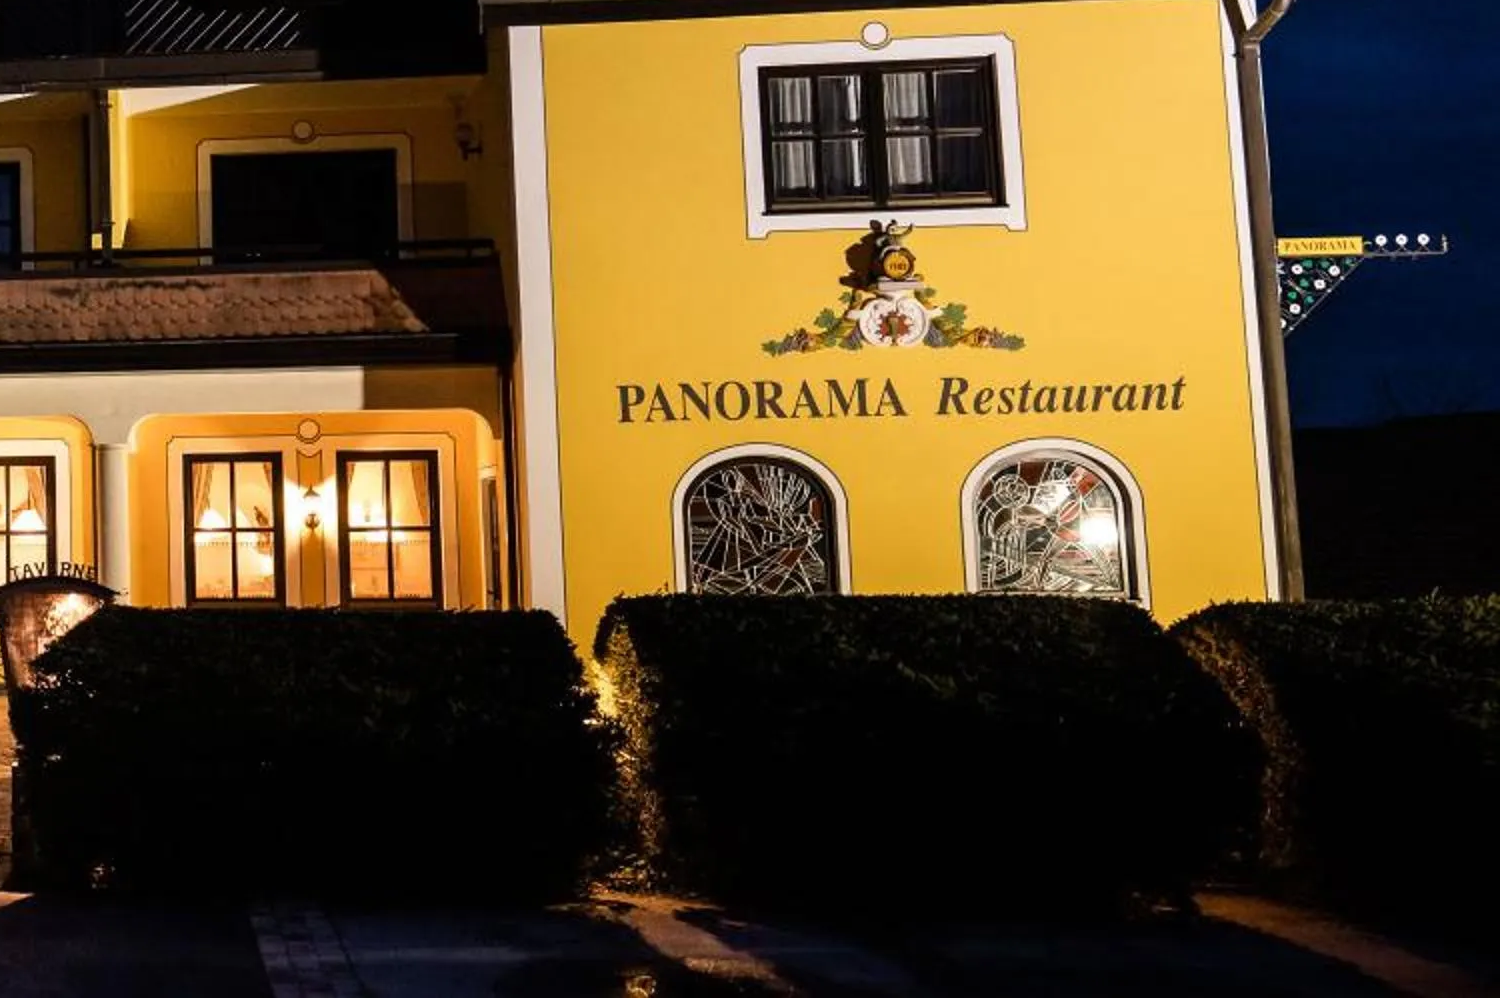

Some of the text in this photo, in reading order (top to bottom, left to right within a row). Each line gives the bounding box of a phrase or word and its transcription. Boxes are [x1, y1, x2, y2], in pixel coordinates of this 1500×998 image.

[1283, 241, 1358, 252] PANORAMA
[616, 376, 1187, 423] PANORAMA Restaurant
[9, 562, 97, 581] TAVRNE
